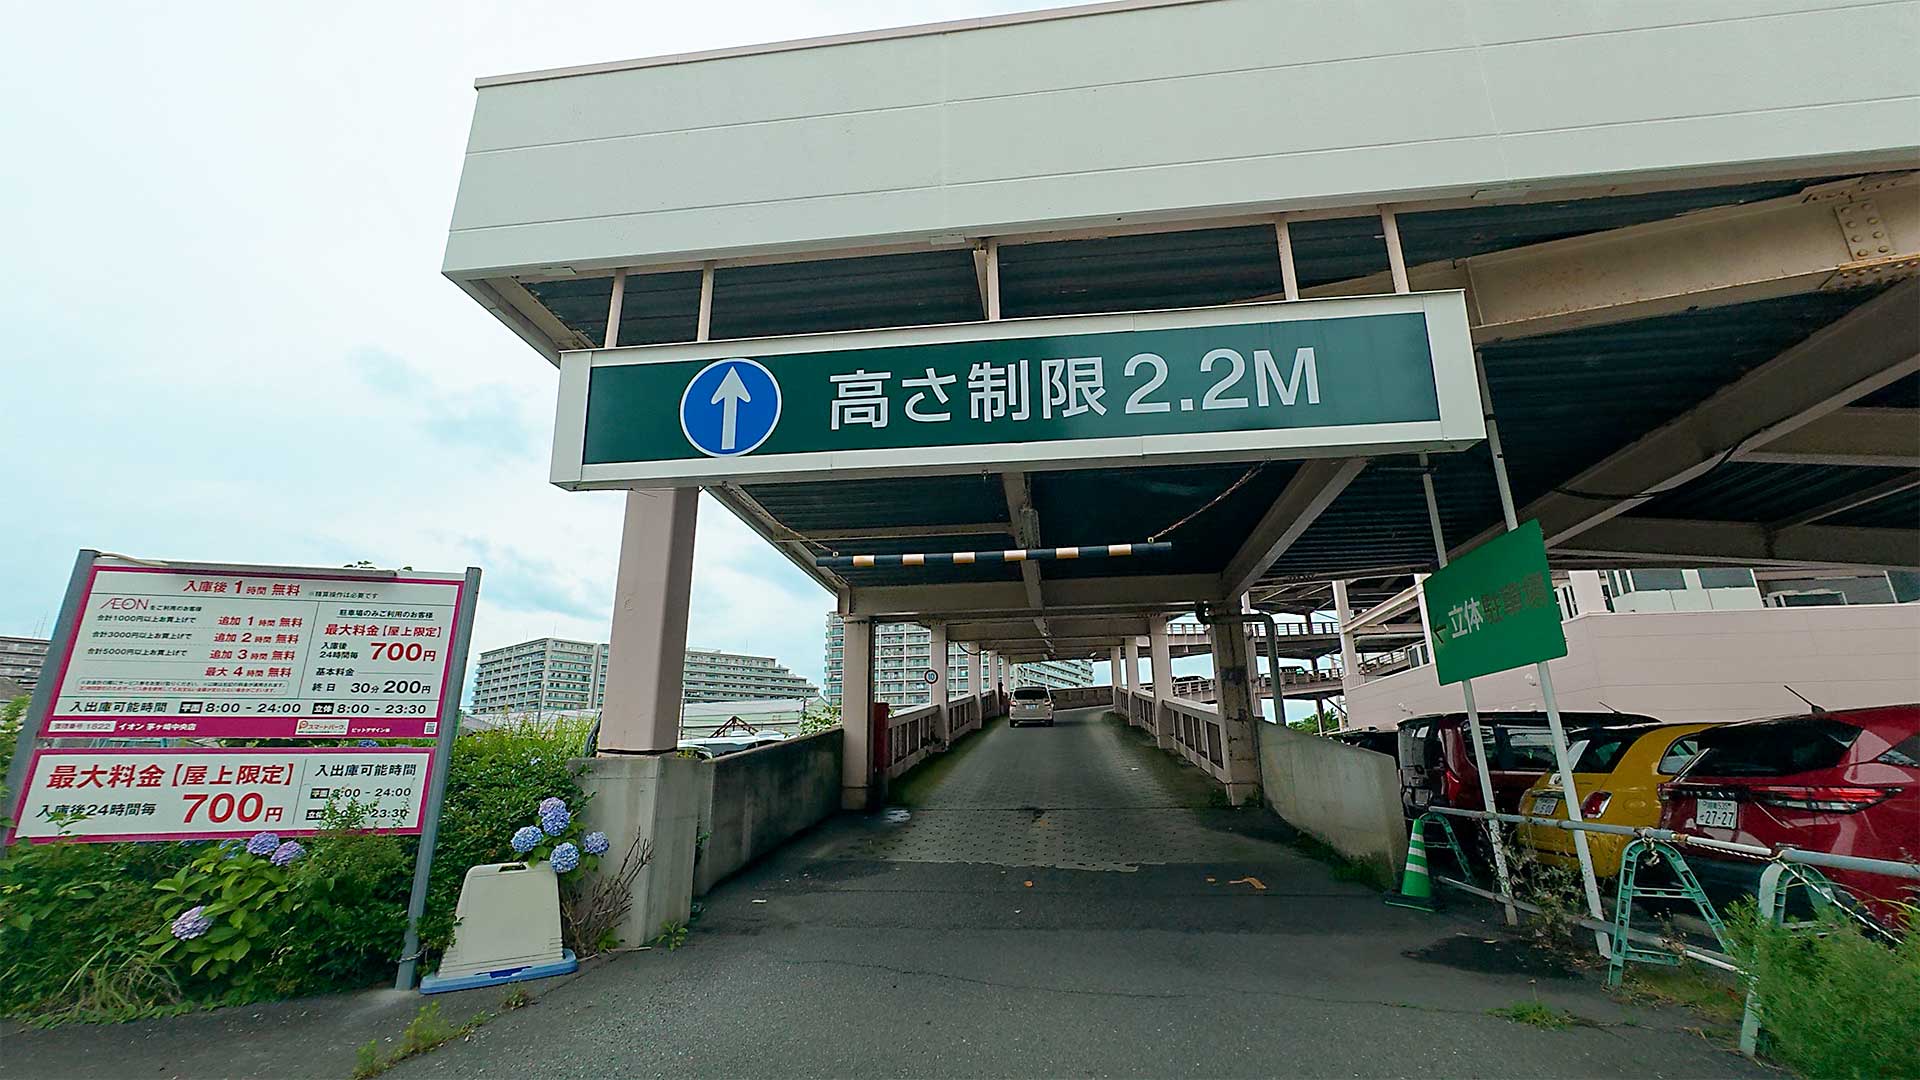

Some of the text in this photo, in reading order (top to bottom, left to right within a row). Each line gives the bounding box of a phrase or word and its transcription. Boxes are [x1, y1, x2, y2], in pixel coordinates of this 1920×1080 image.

[316, 667, 355, 677] 基本料金
[69, 701, 168, 713] 入出庫可能時間
[315, 764, 416, 777] 入出庫可能時間
